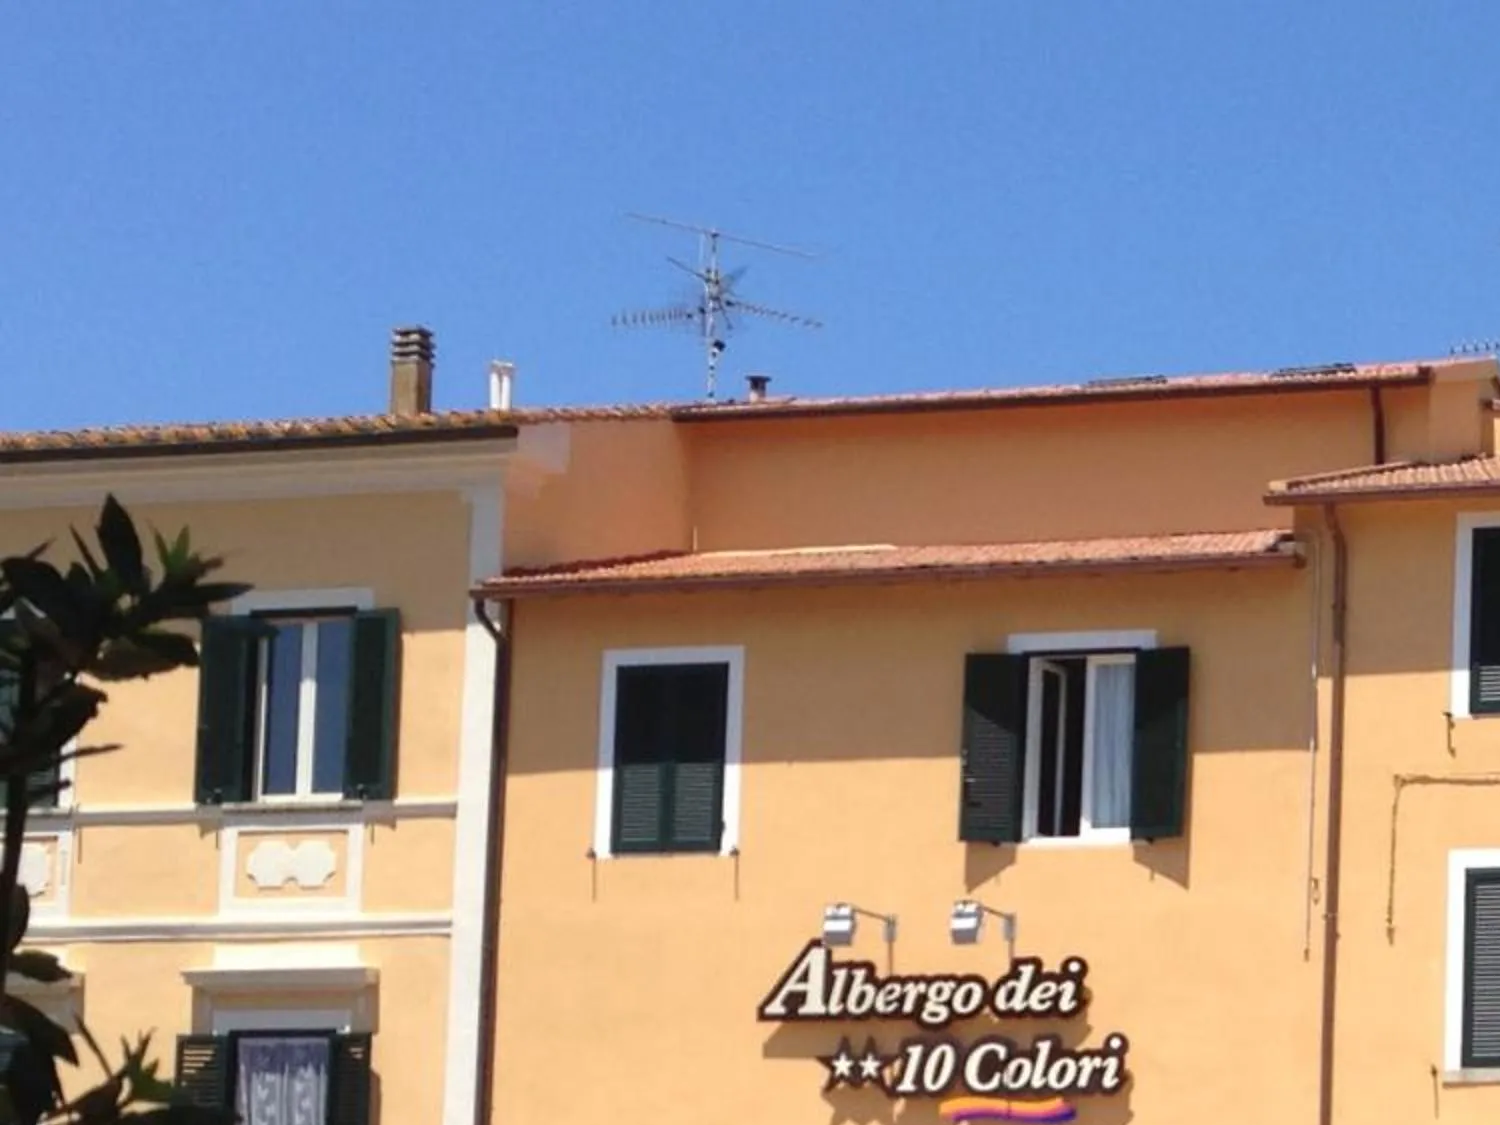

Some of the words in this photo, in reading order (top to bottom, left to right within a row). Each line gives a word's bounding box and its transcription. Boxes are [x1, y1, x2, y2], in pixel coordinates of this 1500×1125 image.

[764, 945, 982, 1023] Albergo
[995, 962, 1081, 1012] dei
[897, 1043, 955, 1092] 10
[964, 1036, 1123, 1092] Colori
